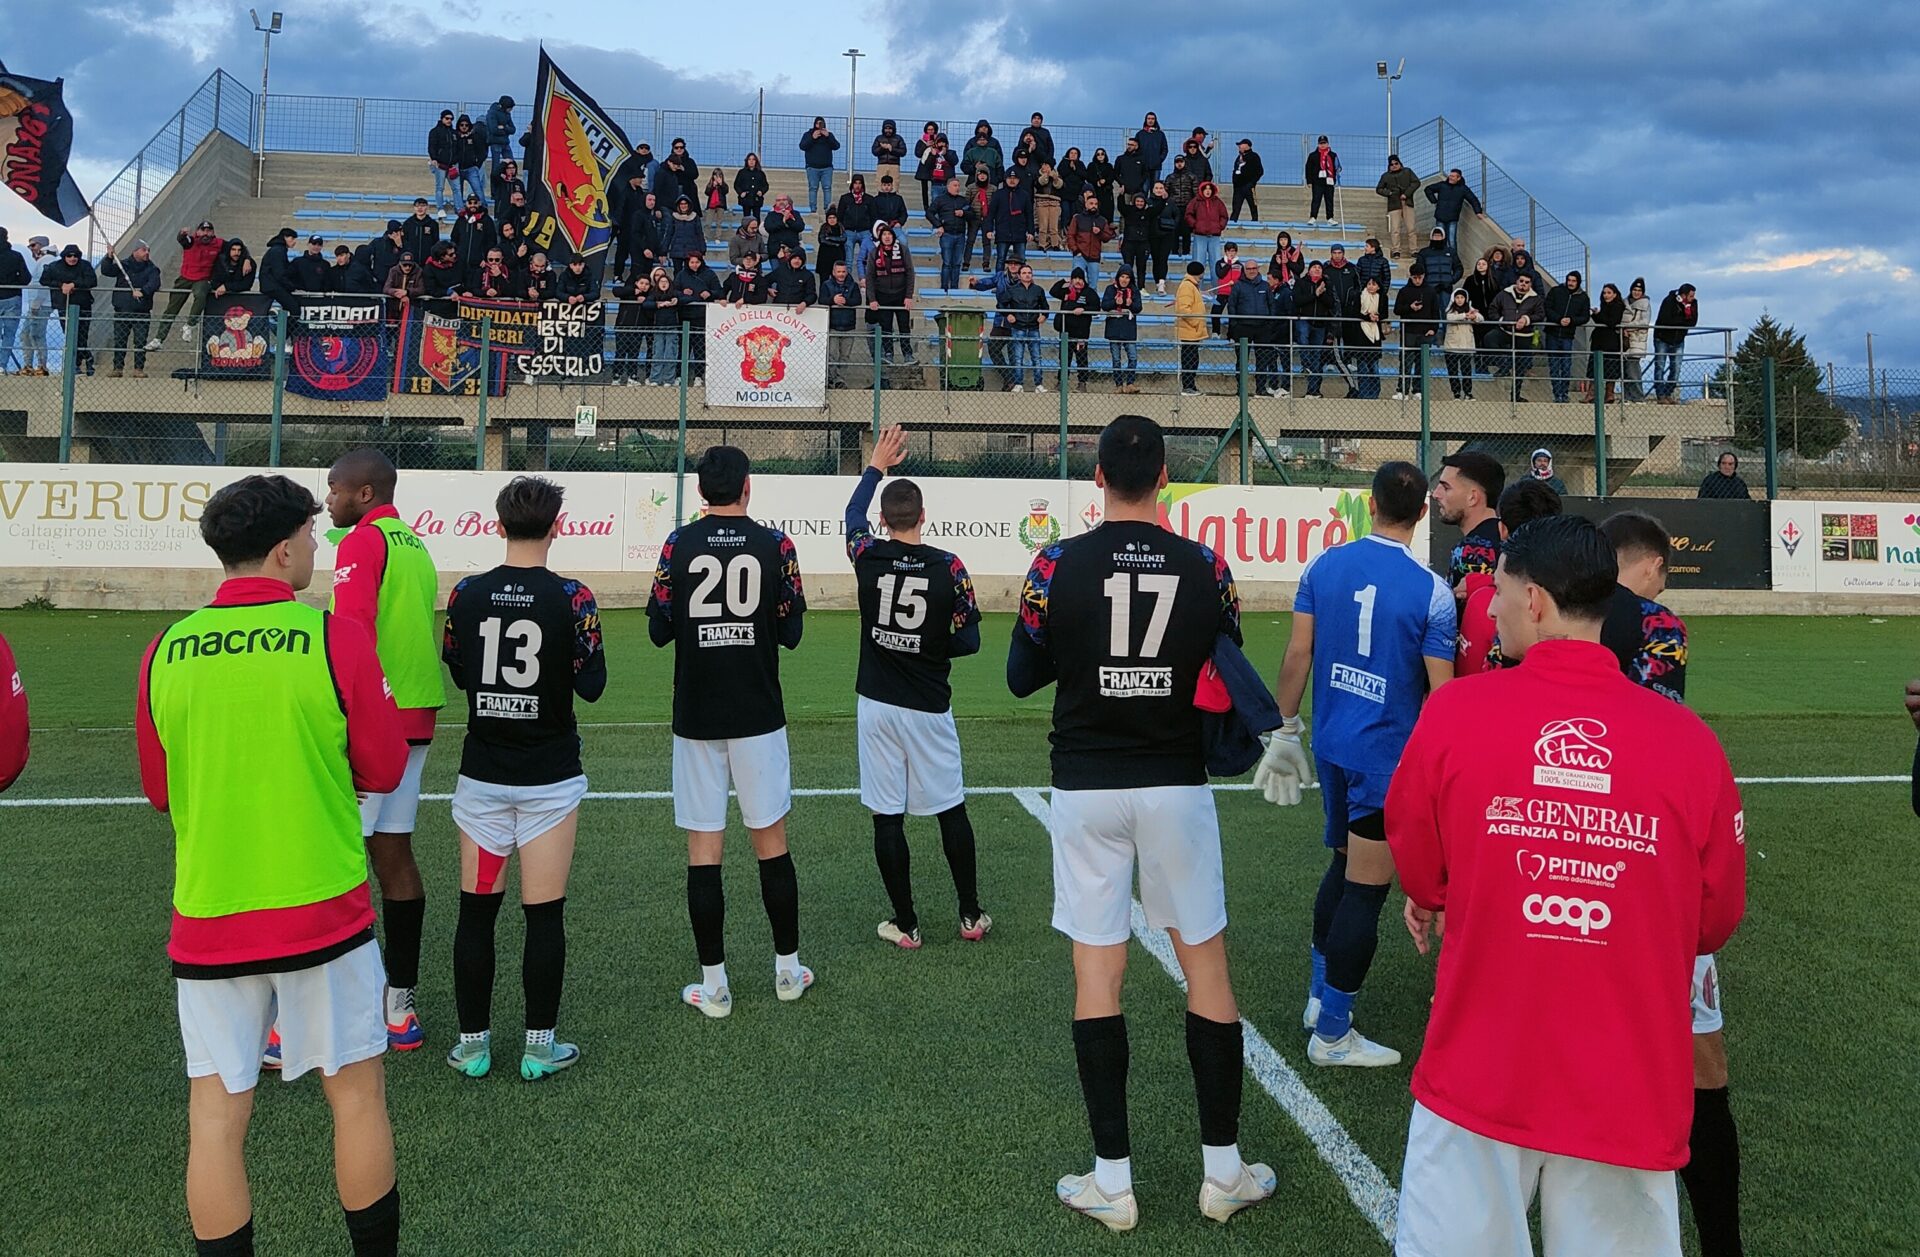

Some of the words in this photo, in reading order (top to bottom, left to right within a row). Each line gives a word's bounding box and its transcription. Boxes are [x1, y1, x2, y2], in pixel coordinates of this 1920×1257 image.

[522, 212, 556, 249] 19
[301, 305, 379, 320] IFFIDATI
[541, 302, 601, 321] TRAS
[471, 325, 523, 344] LBERI
[538, 320, 585, 337] IBERI
[713, 317, 737, 341] FIGLI
[739, 311, 773, 322] DELLA
[776, 312, 817, 343] CONTEA
[544, 337, 563, 353] DI
[517, 354, 602, 376] ESSERLO
[411, 376, 432, 393] 19
[736, 391, 792, 402] MODICA
[8, 524, 107, 539] Caltagirone
[113, 524, 158, 539] Sicily
[165, 525, 200, 540] Italy
[409, 509, 446, 537] La
[757, 520, 831, 536] OMUNE
[97, 541, 130, 551] 0933
[1113, 553, 1165, 562] ECCELLENZE
[688, 554, 761, 618] 20
[491, 592, 534, 602] ECCELLENZE
[877, 573, 929, 630] 15
[1104, 572, 1181, 658] 17
[1354, 584, 1377, 658] 1
[698, 623, 755, 640] FRANZY'S
[872, 627, 921, 648] FRANZY'S
[167, 628, 311, 664] macron
[479, 617, 542, 688] 13
[1099, 666, 1173, 689] FRANZY'S
[1331, 662, 1387, 697] FRANZY'S
[476, 692, 539, 713] FRANZY'S
[1541, 734, 1610, 769] Etna
[1540, 776, 1560, 784] 100%
[1562, 779, 1604, 790] SICILIANO
[1527, 799, 1660, 841] GENERALI
[1487, 823, 1558, 840] AGENZIA
[1563, 830, 1581, 843] DI
[1585, 833, 1657, 856] MODICA
[1548, 874, 1570, 882] centro
[1571, 877, 1616, 889] odontoiatrico
[1522, 894, 1611, 935] coop
